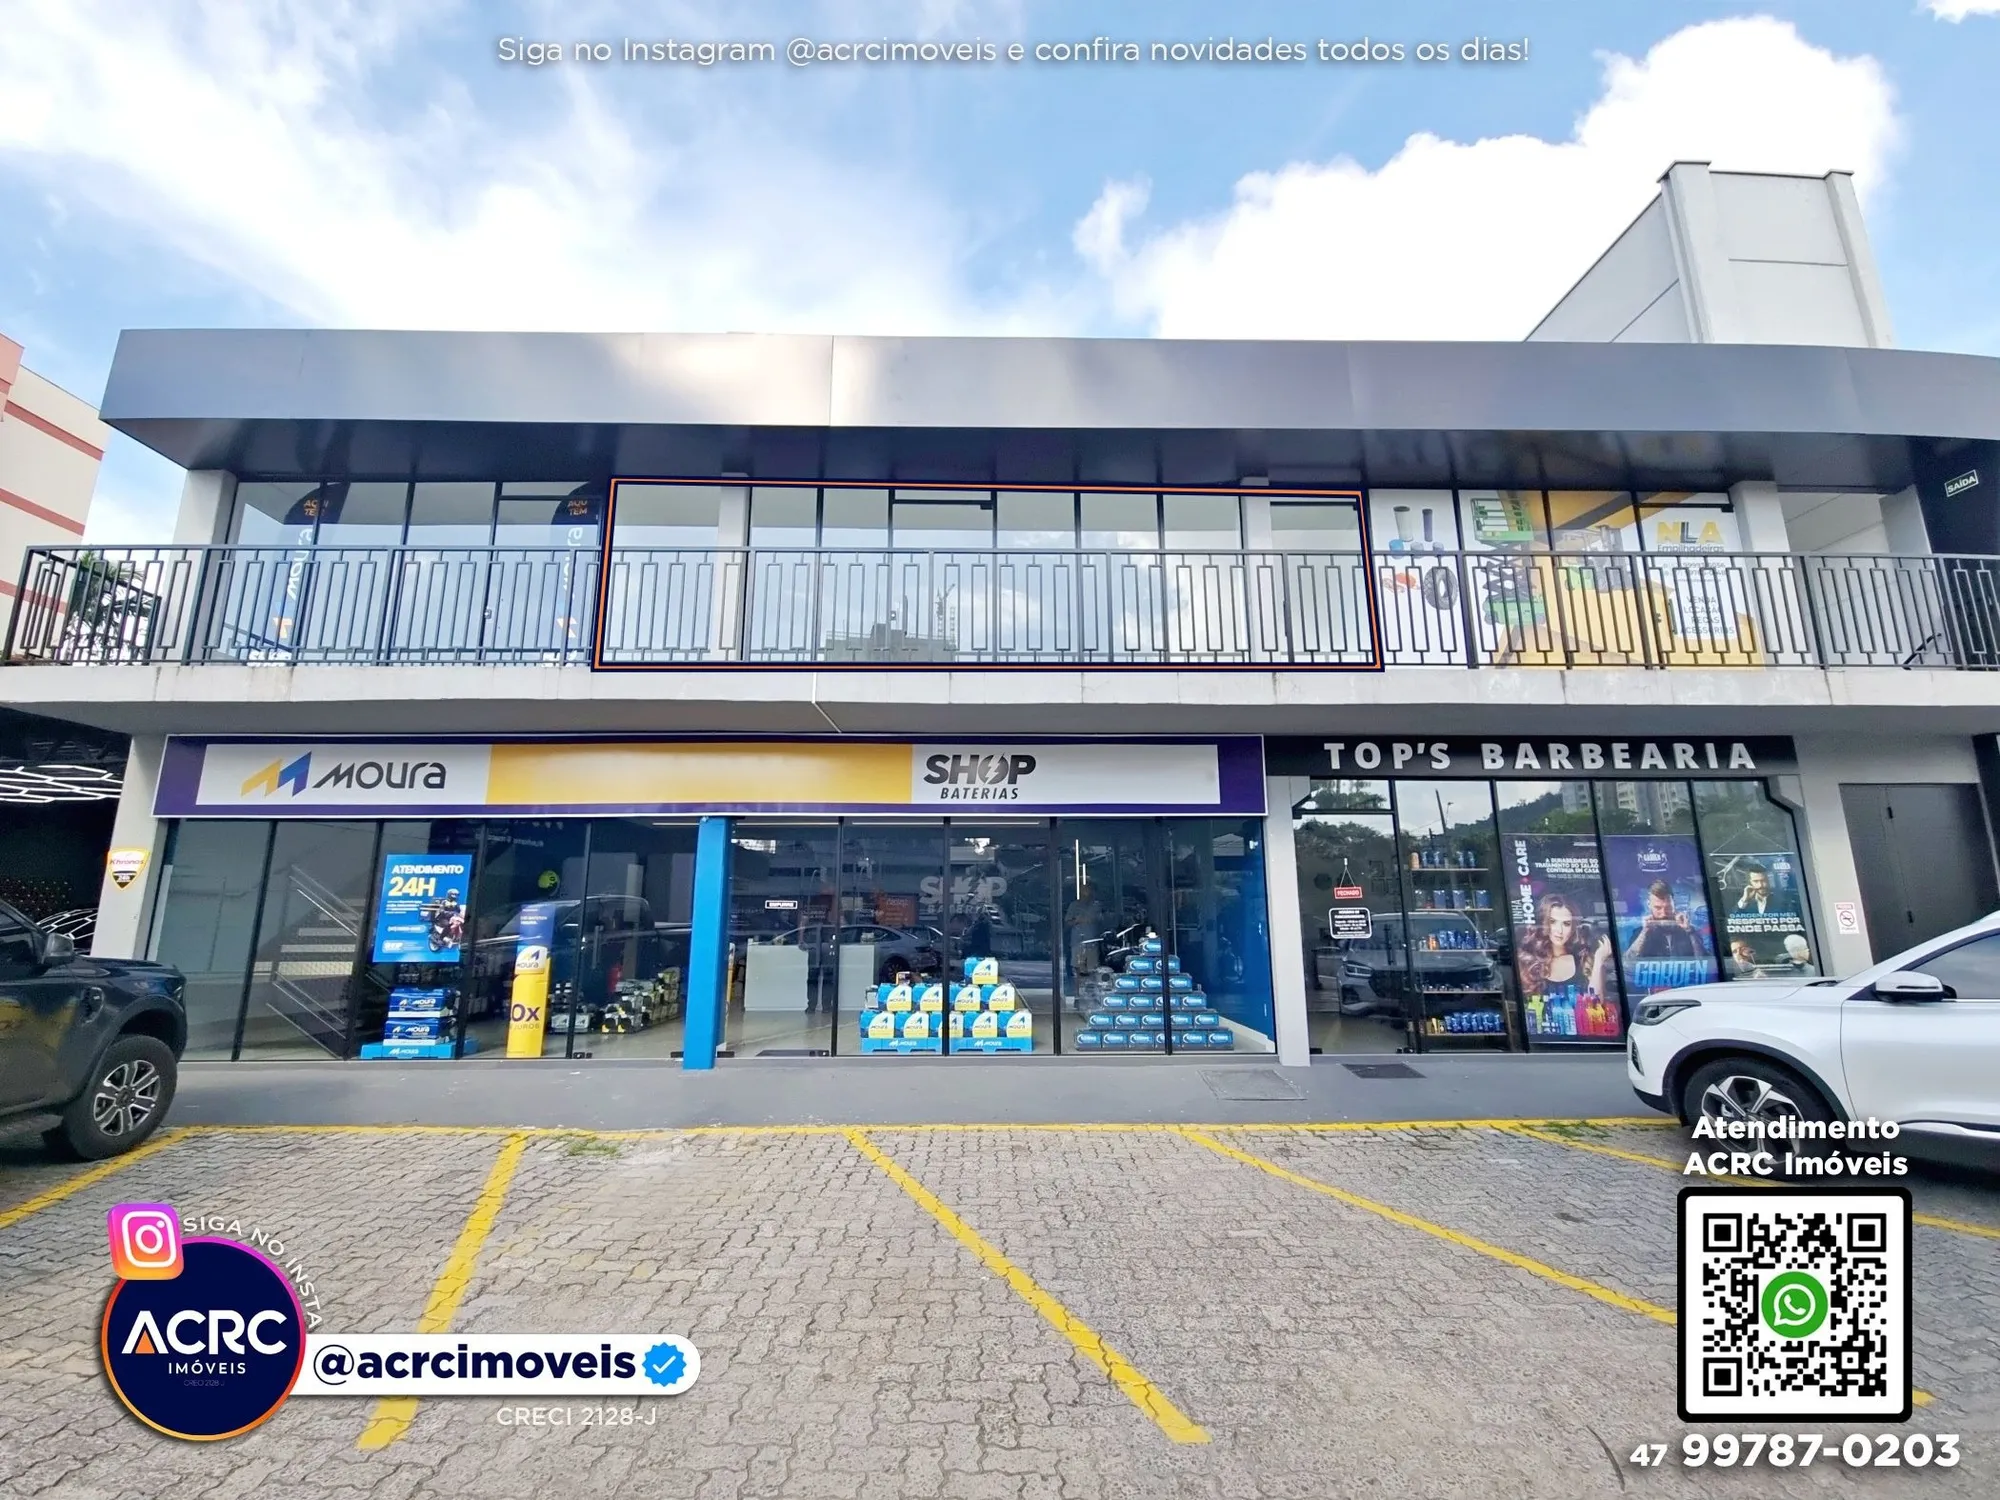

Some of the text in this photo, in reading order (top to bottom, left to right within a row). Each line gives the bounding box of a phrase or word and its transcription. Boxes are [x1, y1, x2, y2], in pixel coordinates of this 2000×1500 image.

[1656, 521, 1726, 544] NLA
[1686, 596, 1717, 604] VENA
[1323, 742, 1756, 770] TOP'S BARBEARIA
[923, 753, 1037, 785] SHOP
[940, 787, 1019, 800] BATERIAS
[391, 864, 465, 875] ATENDIMENTO
[1514, 840, 1530, 877] CARE
[387, 876, 437, 897] 24H
[1511, 900, 1525, 924] LINHA
[1520, 884, 1536, 925] HOME
[1727, 924, 1806, 933] ONDE PASSA
[1635, 960, 1709, 987] GARDEN
